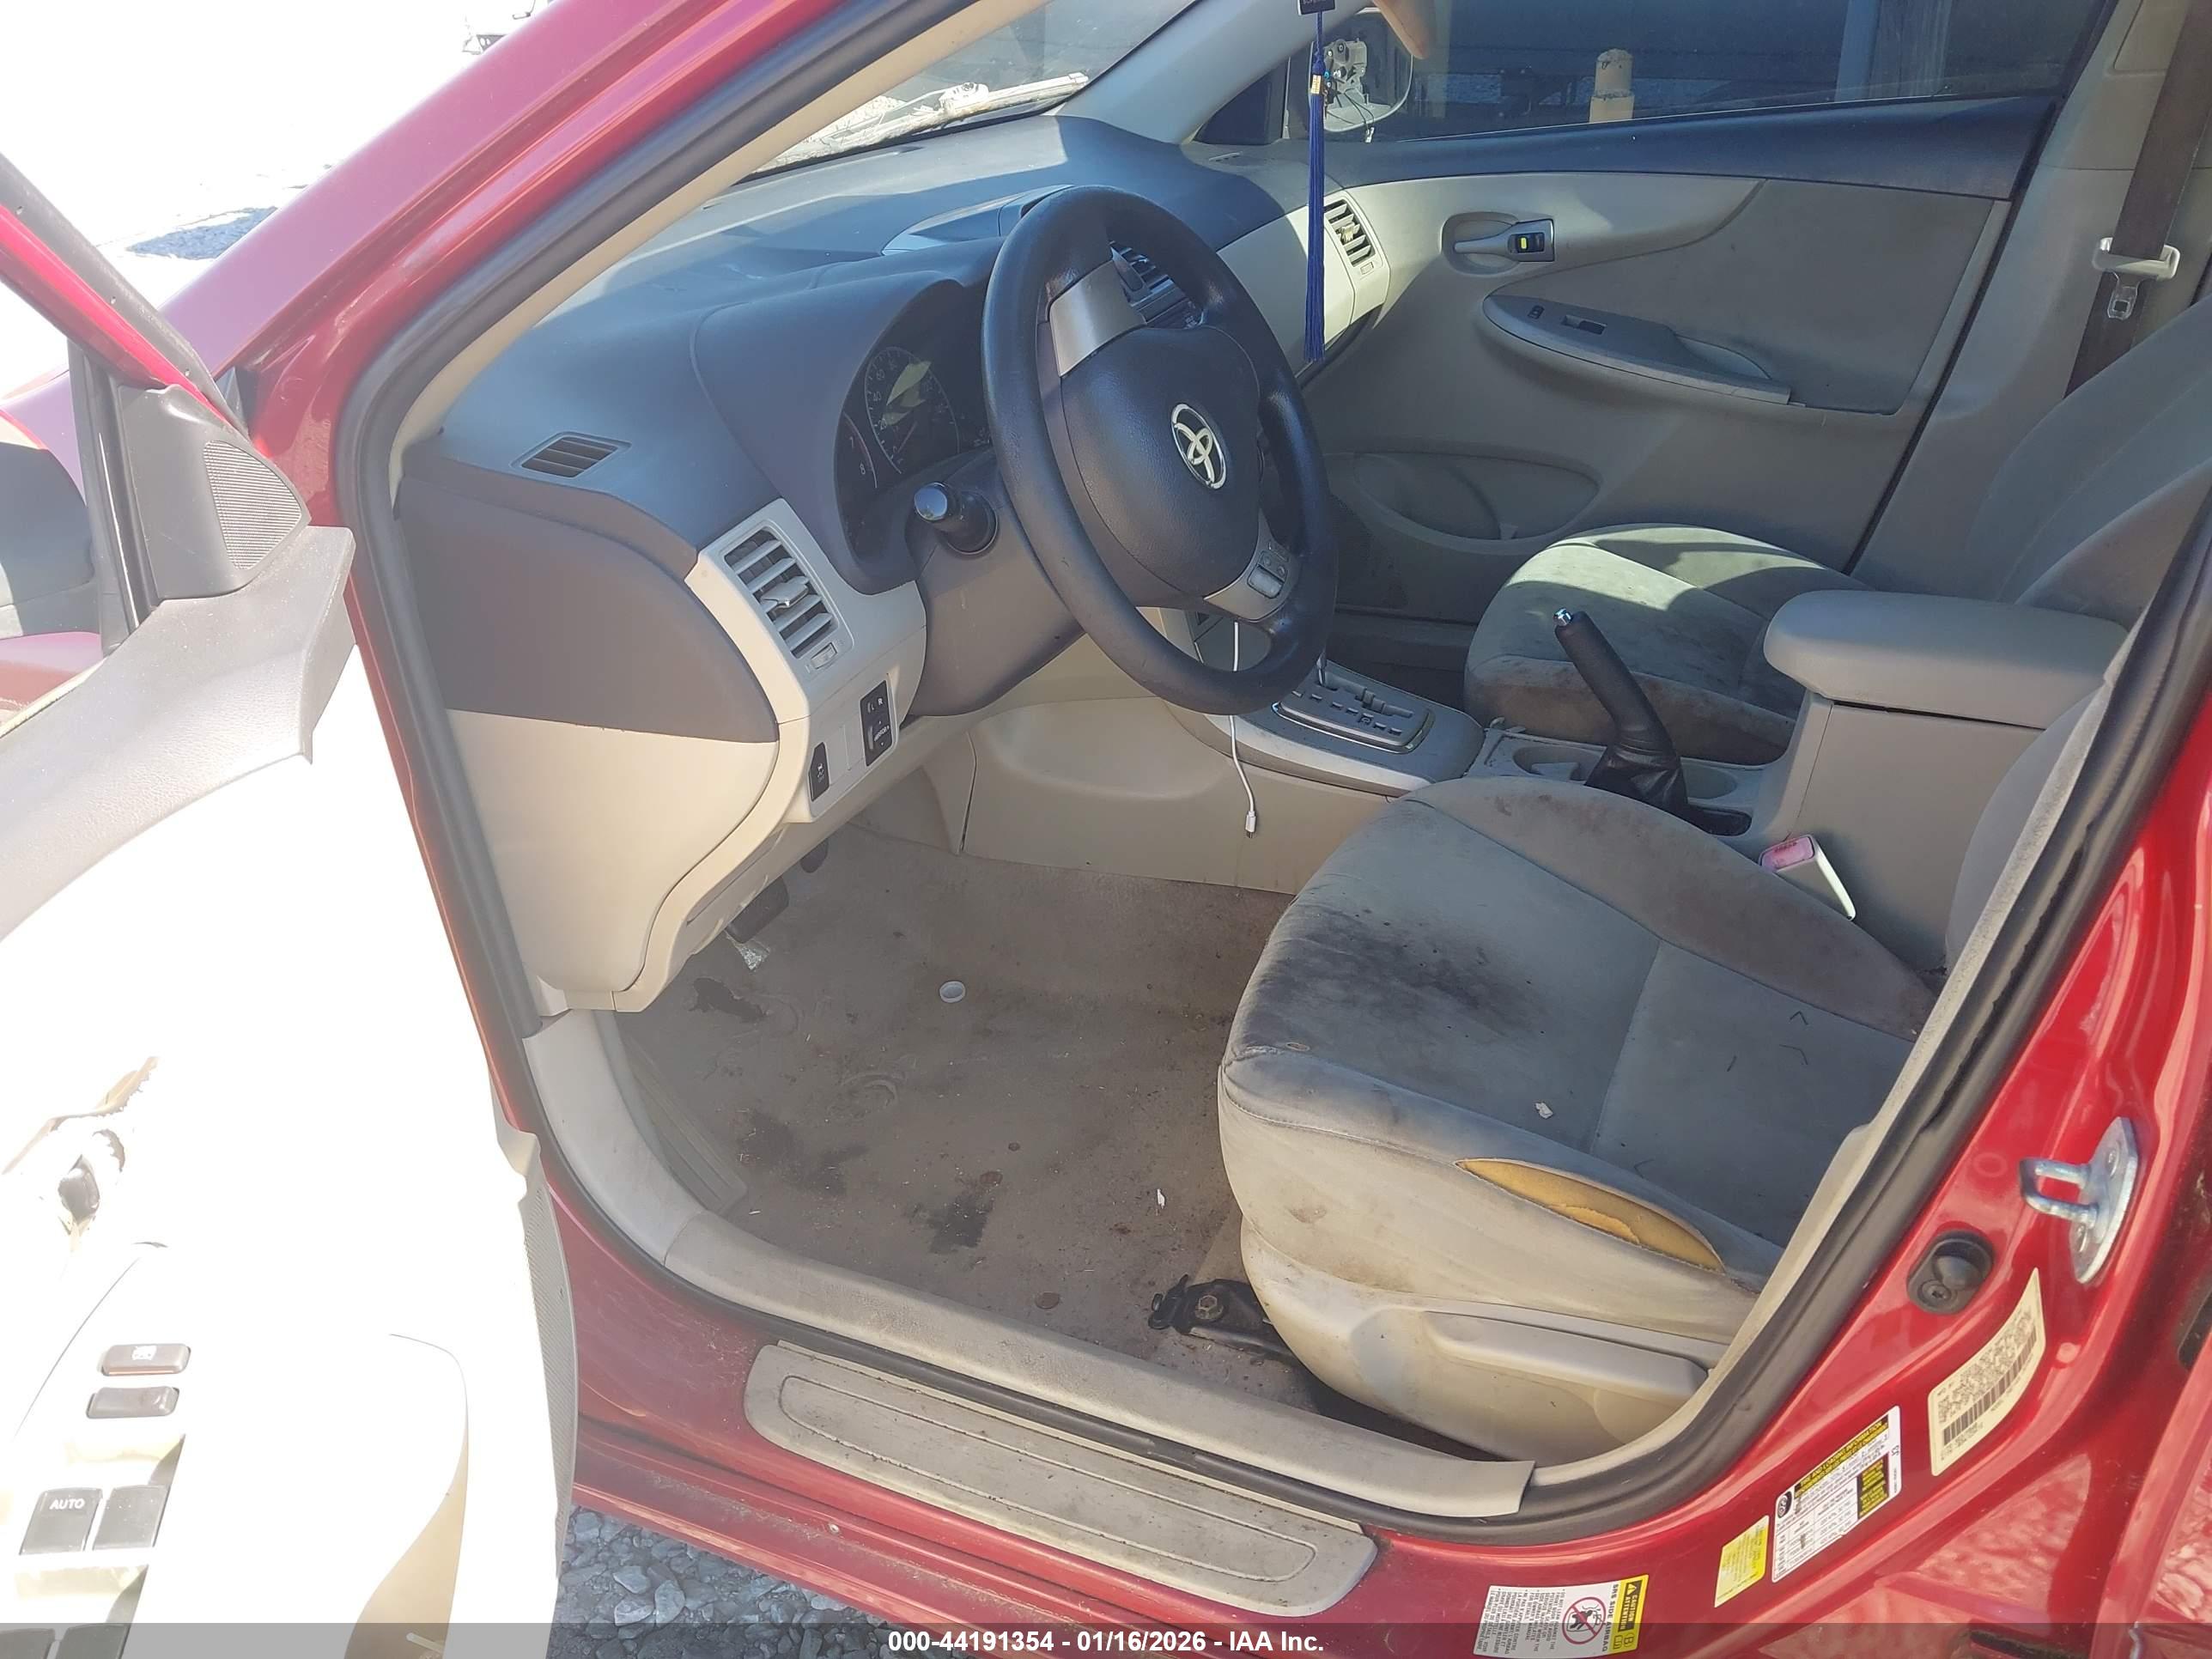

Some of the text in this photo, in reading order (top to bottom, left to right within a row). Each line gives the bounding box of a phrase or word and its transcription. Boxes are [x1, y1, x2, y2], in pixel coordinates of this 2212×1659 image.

[878, 697, 883, 706] R
[1845, 1421, 1883, 1453] INFORMATION
[49, 1498, 85, 1510] AUTO
[1607, 1601, 1615, 1618] SIDE
[1620, 1596, 1630, 1629] ATTENTION
[1627, 1594, 1638, 1621] CAUTION
[1601, 1621, 1612, 1651] AIRBAG
